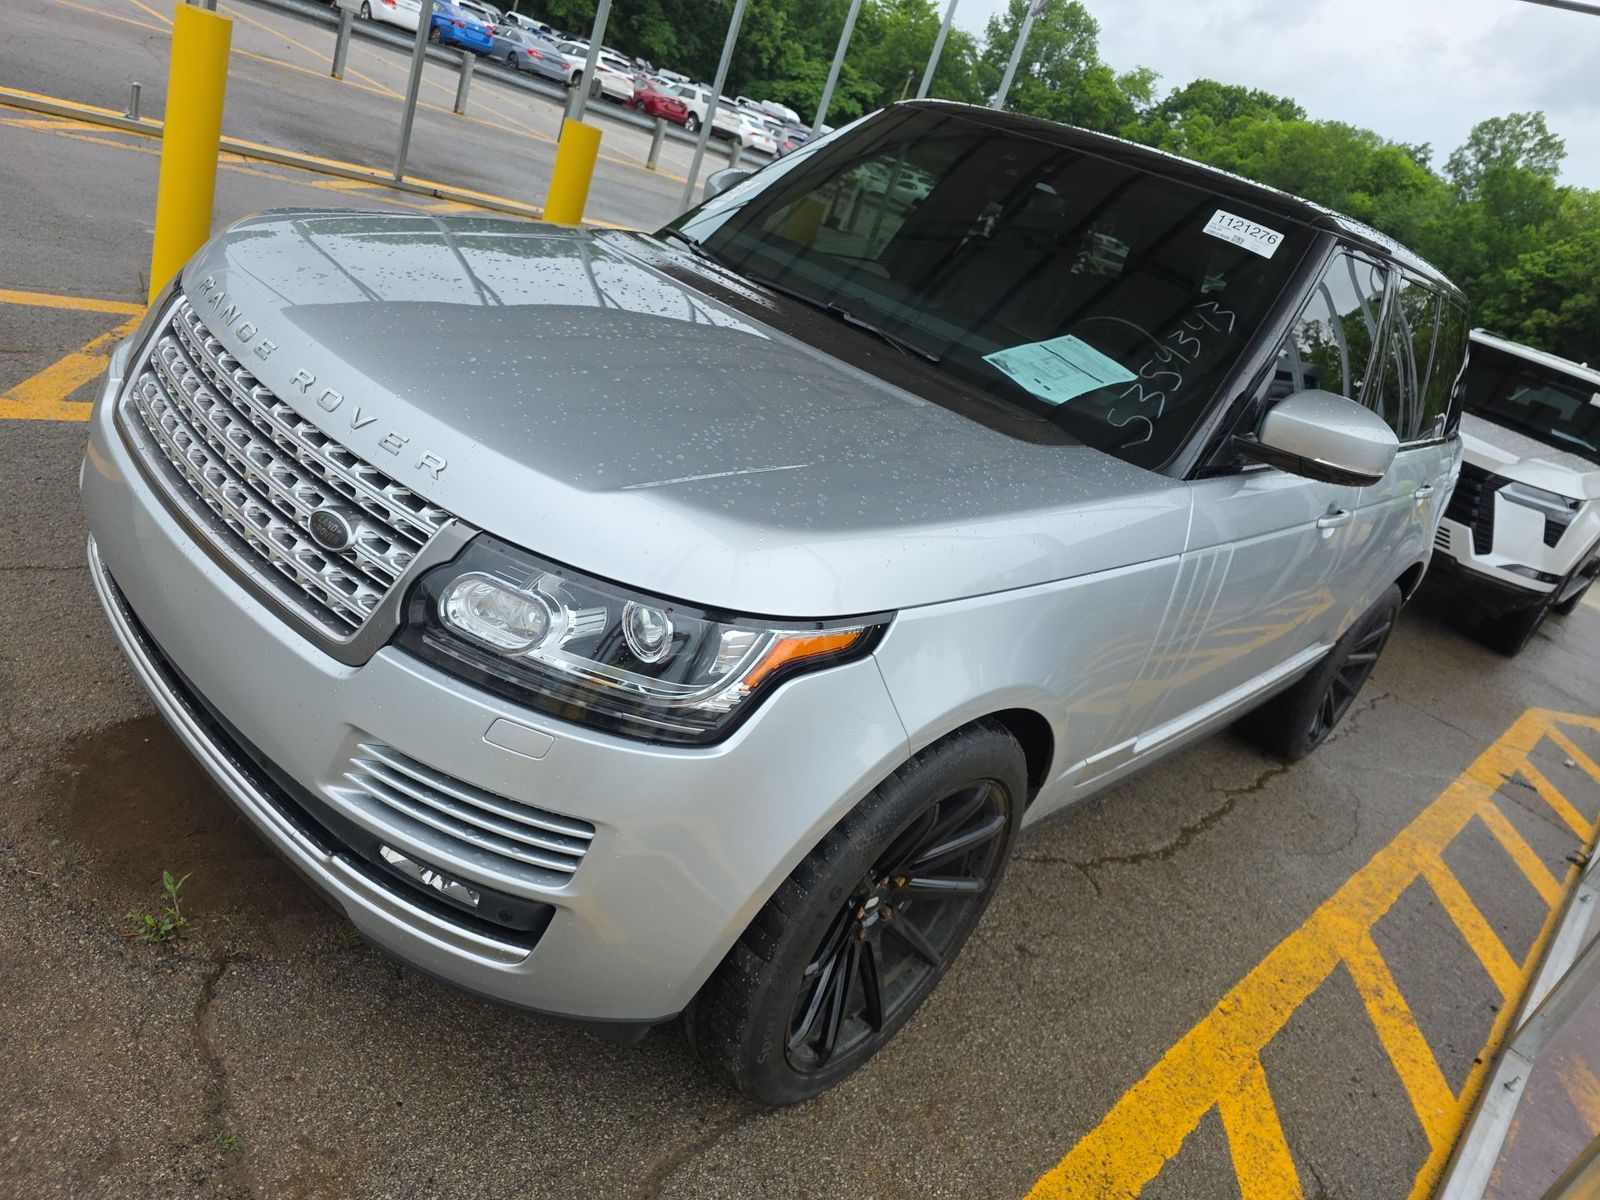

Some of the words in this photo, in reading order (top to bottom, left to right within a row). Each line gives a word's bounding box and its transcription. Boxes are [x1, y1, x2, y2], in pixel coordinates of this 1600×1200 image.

[1218, 214, 1279, 246] 1121276
[199, 274, 278, 361] RANGE
[289, 367, 448, 481] ROVER
